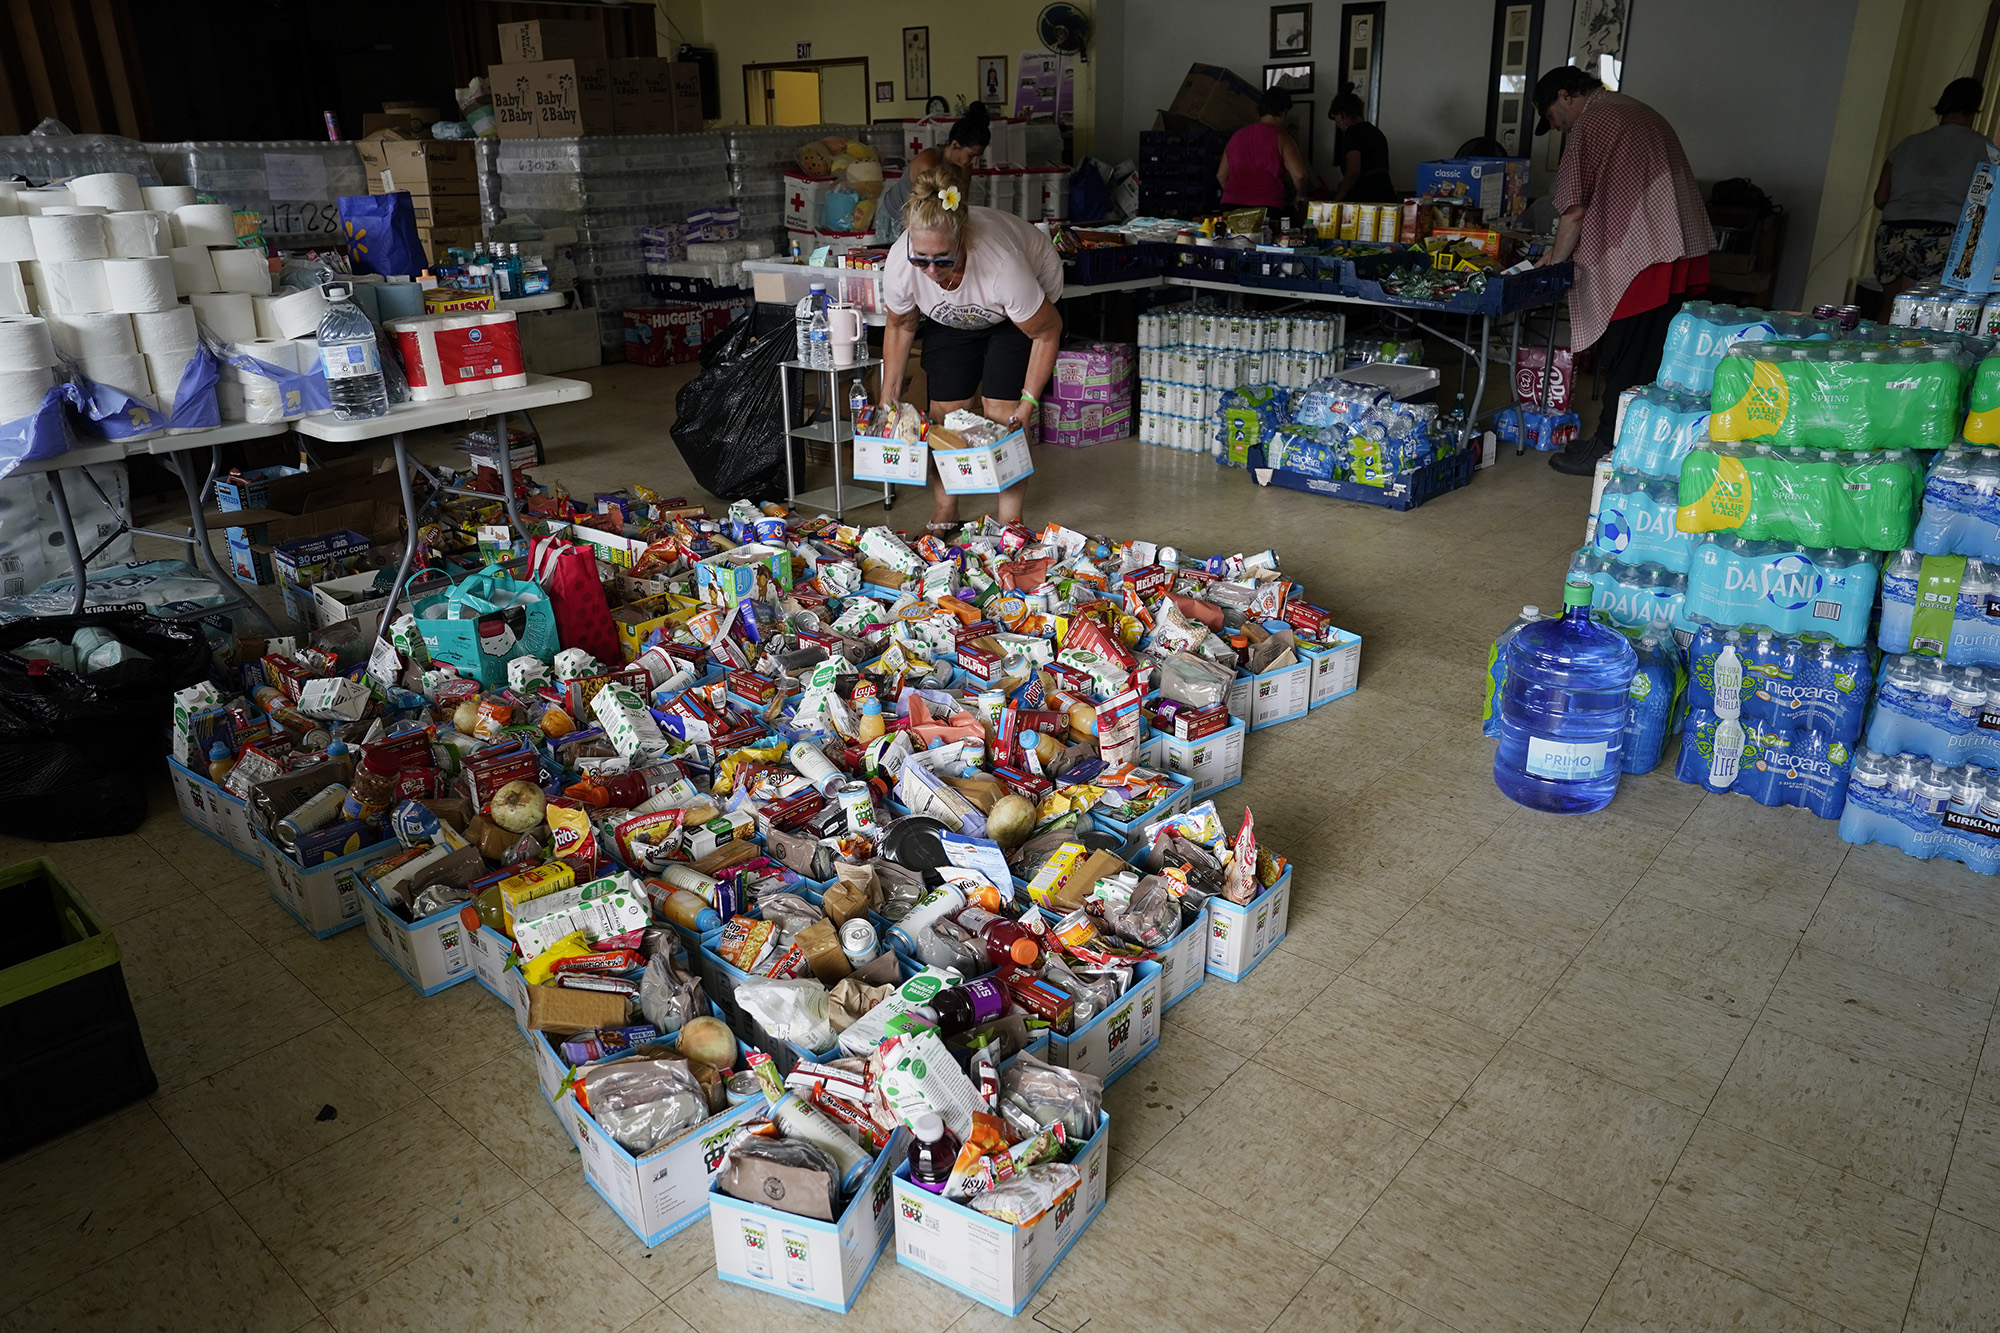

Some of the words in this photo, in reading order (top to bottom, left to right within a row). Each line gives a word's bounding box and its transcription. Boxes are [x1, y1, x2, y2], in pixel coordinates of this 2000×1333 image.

[797, 43, 812, 59] EXIT
[581, 75, 599, 85] Baby
[613, 78, 631, 88] Baby
[494, 93, 521, 110] Baby
[536, 91, 563, 107] Baby
[1434, 168, 1462, 179] classic
[786, 214, 808, 224] American
[652, 310, 704, 328] HUGGIES
[1520, 376, 1532, 389] 23
[1751, 387, 1779, 401] 28
[1811, 392, 1849, 403] SPRING
[1066, 401, 1076, 409] 24
[1746, 406, 1781, 417] VALUE
[1748, 413, 1778, 426] PACK
[1290, 450, 1321, 471] niagara
[1715, 482, 1742, 498] 28
[1772, 490, 1810, 501] SPRING
[1710, 500, 1745, 513] VALUE
[1712, 507, 1742, 520] PACK
[298, 554, 311, 564] 30
[312, 548, 348, 562] CRUNCHY
[349, 543, 370, 553] CORN
[1136, 573, 1166, 590] HELPER
[1725, 566, 1816, 600] DASANI
[1830, 576, 1846, 586] 24
[1924, 593, 1952, 604] 80
[1600, 589, 1677, 623] DASANI
[1919, 601, 1954, 613] BOTTLES
[1954, 633, 2000, 647] purifi
[958, 653, 989, 679] HELPER
[1716, 671, 1739, 688] VIDA
[1838, 677, 1851, 686] 24
[853, 683, 877, 699] Lay's
[1717, 686, 1722, 697] A
[1723, 688, 1738, 700] ESTA
[1765, 680, 1839, 707] niagara
[1715, 699, 1739, 710] BOTELLA
[1717, 735, 1741, 749] BOTTLE
[1948, 734, 2000, 748] purifie
[1716, 747, 1739, 758] ANOTHER
[1831, 748, 1845, 758] 24
[1545, 753, 1591, 767] PRIMO
[1713, 755, 1735, 777] LIFE
[1764, 749, 1831, 777] niagara
[401, 777, 425, 790] FROOT
[403, 784, 426, 796] LOOPS
[651, 813, 677, 822] ANIMALS
[1947, 814, 2000, 834] KIRKLAN
[645, 836, 679, 858] Goldfish
[1913, 832, 1978, 853] purified
[726, 919, 741, 933] Top
[721, 929, 746, 942] Ramen
[907, 987, 931, 999] pantry
[909, 981, 933, 996] modern
[1107, 1015, 1130, 1041] COCO
